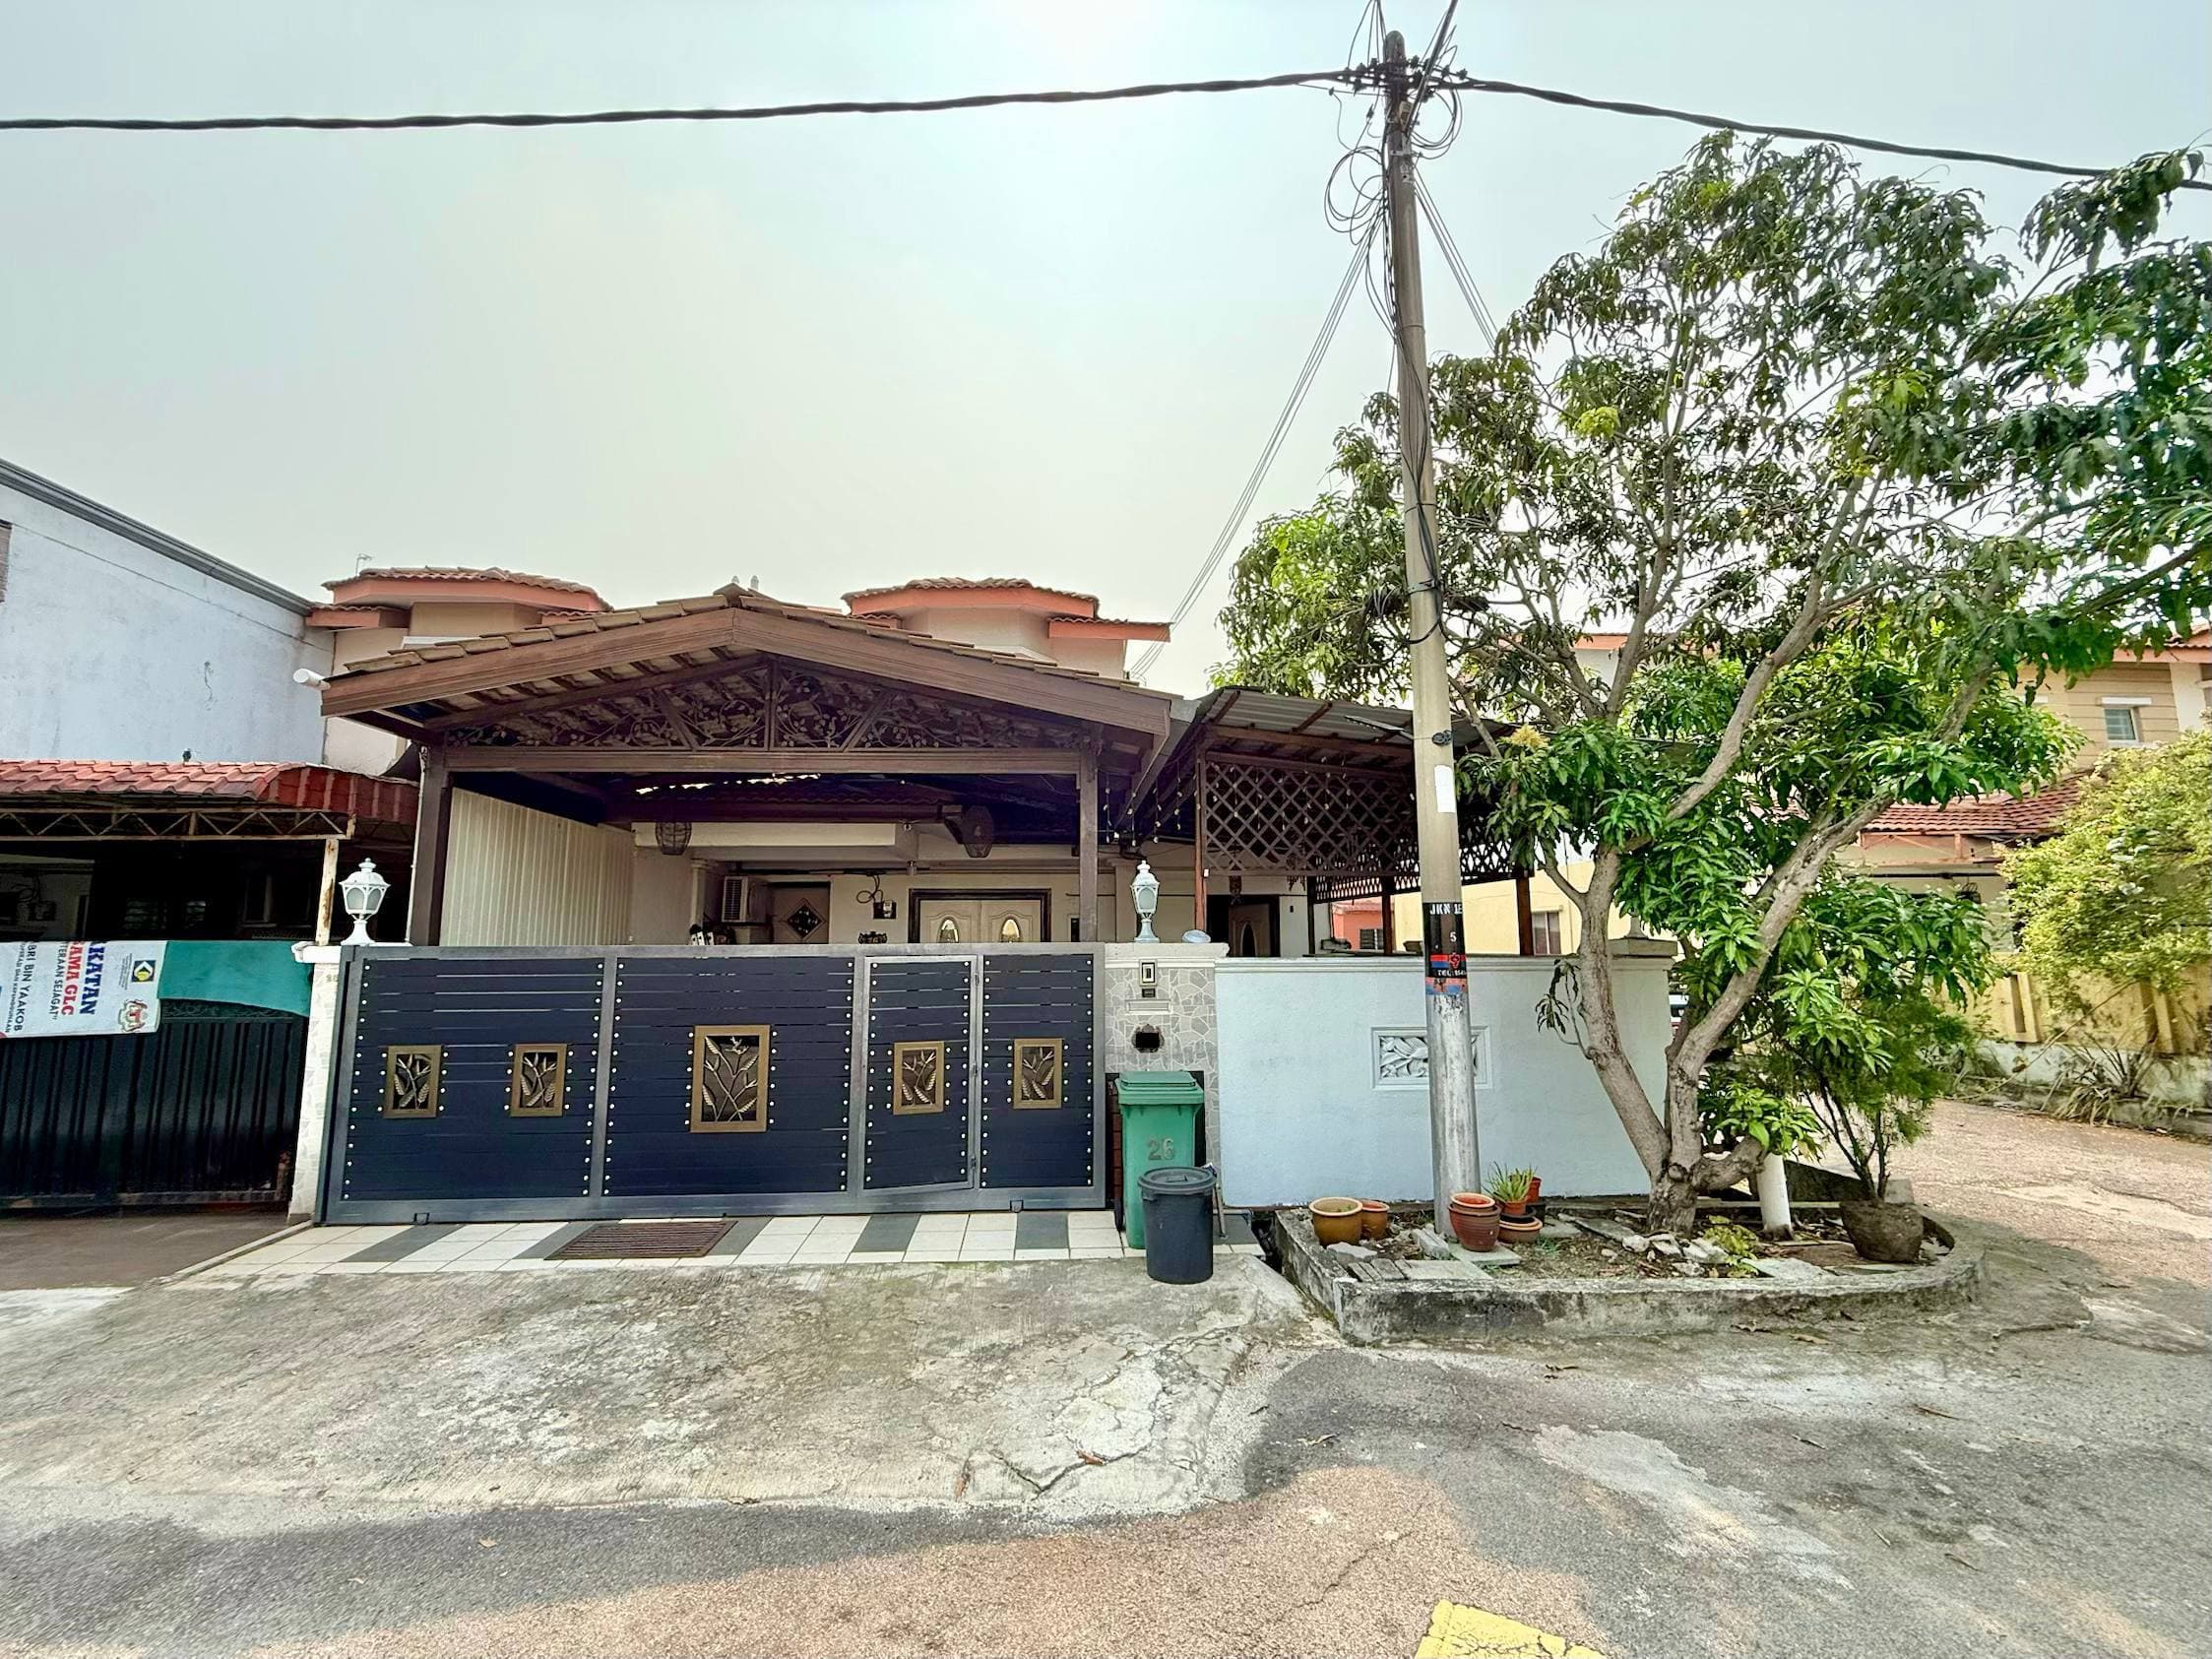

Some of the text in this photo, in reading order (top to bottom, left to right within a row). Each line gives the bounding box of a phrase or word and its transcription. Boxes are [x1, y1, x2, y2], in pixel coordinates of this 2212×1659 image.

[1449, 931, 1457, 942] 5
[23, 964, 33, 982] BIN
[14, 983, 32, 1032] YAAKOB
[61, 985, 79, 1015] GLC
[1149, 1138, 1175, 1160] 26
